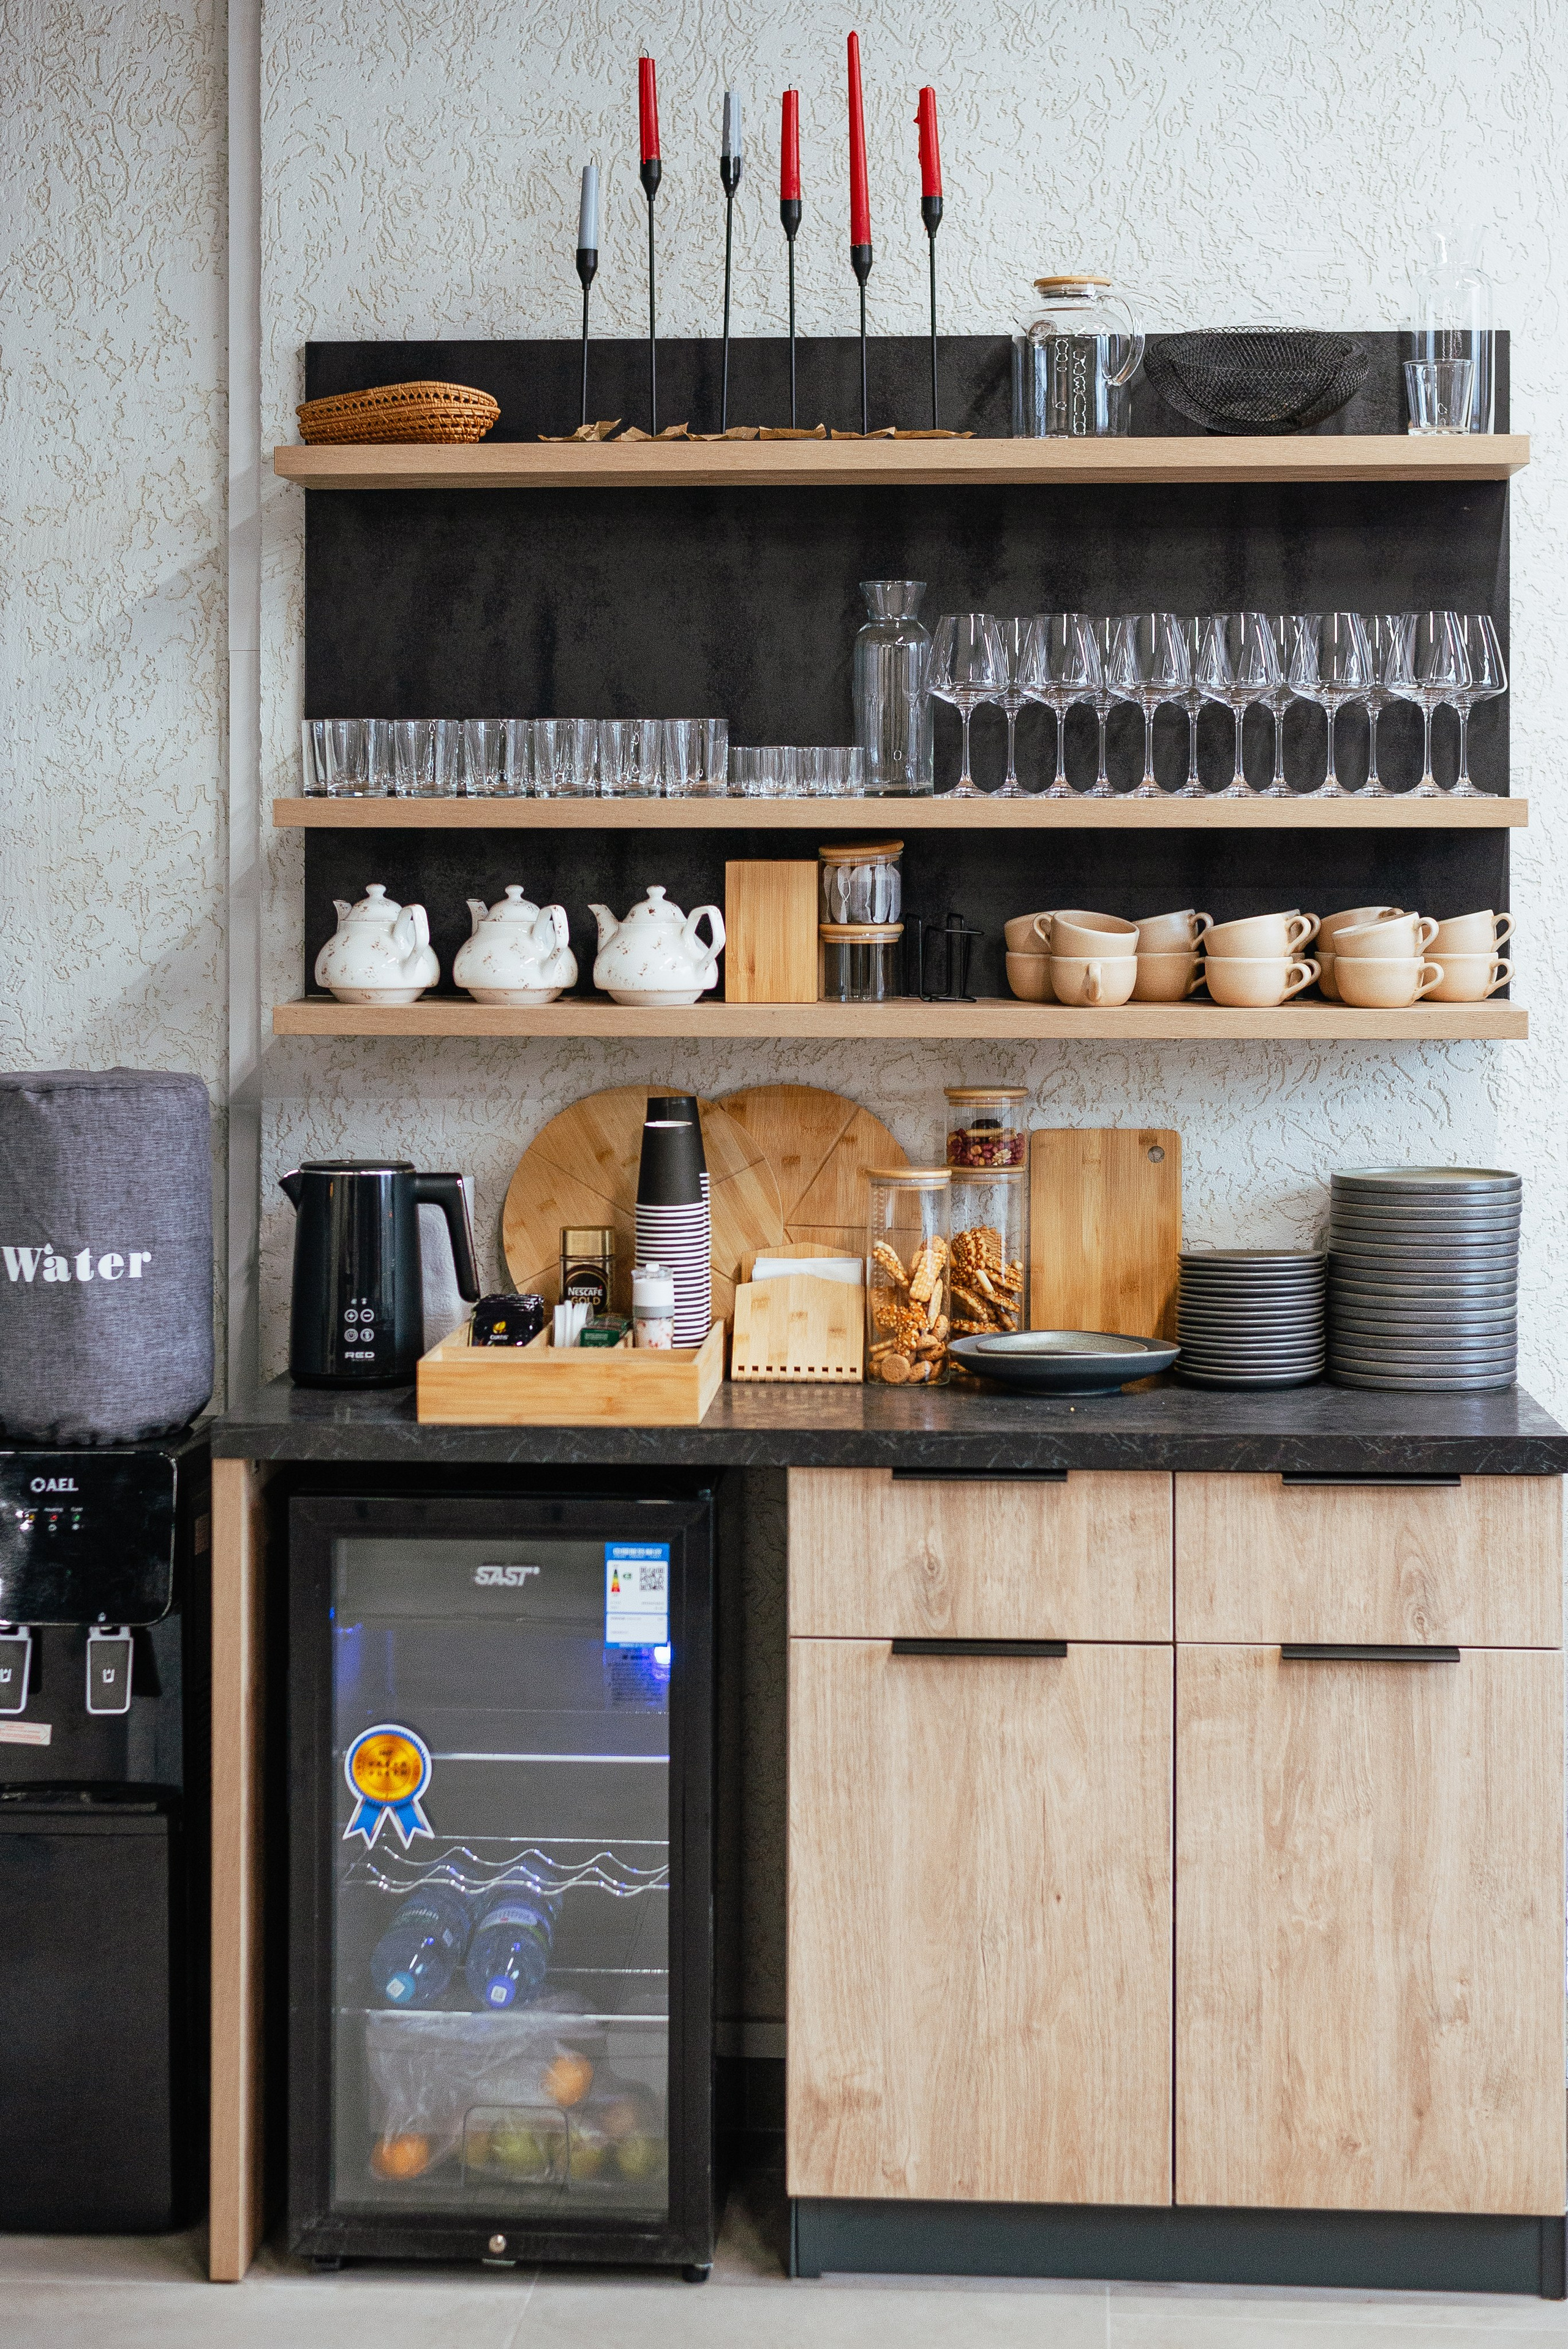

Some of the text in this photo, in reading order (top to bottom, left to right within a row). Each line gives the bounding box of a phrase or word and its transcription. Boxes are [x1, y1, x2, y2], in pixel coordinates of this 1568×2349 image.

[1, 1244, 152, 1282] Water
[571, 1296, 600, 1305] GOLD
[475, 1565, 532, 1586] SAST
